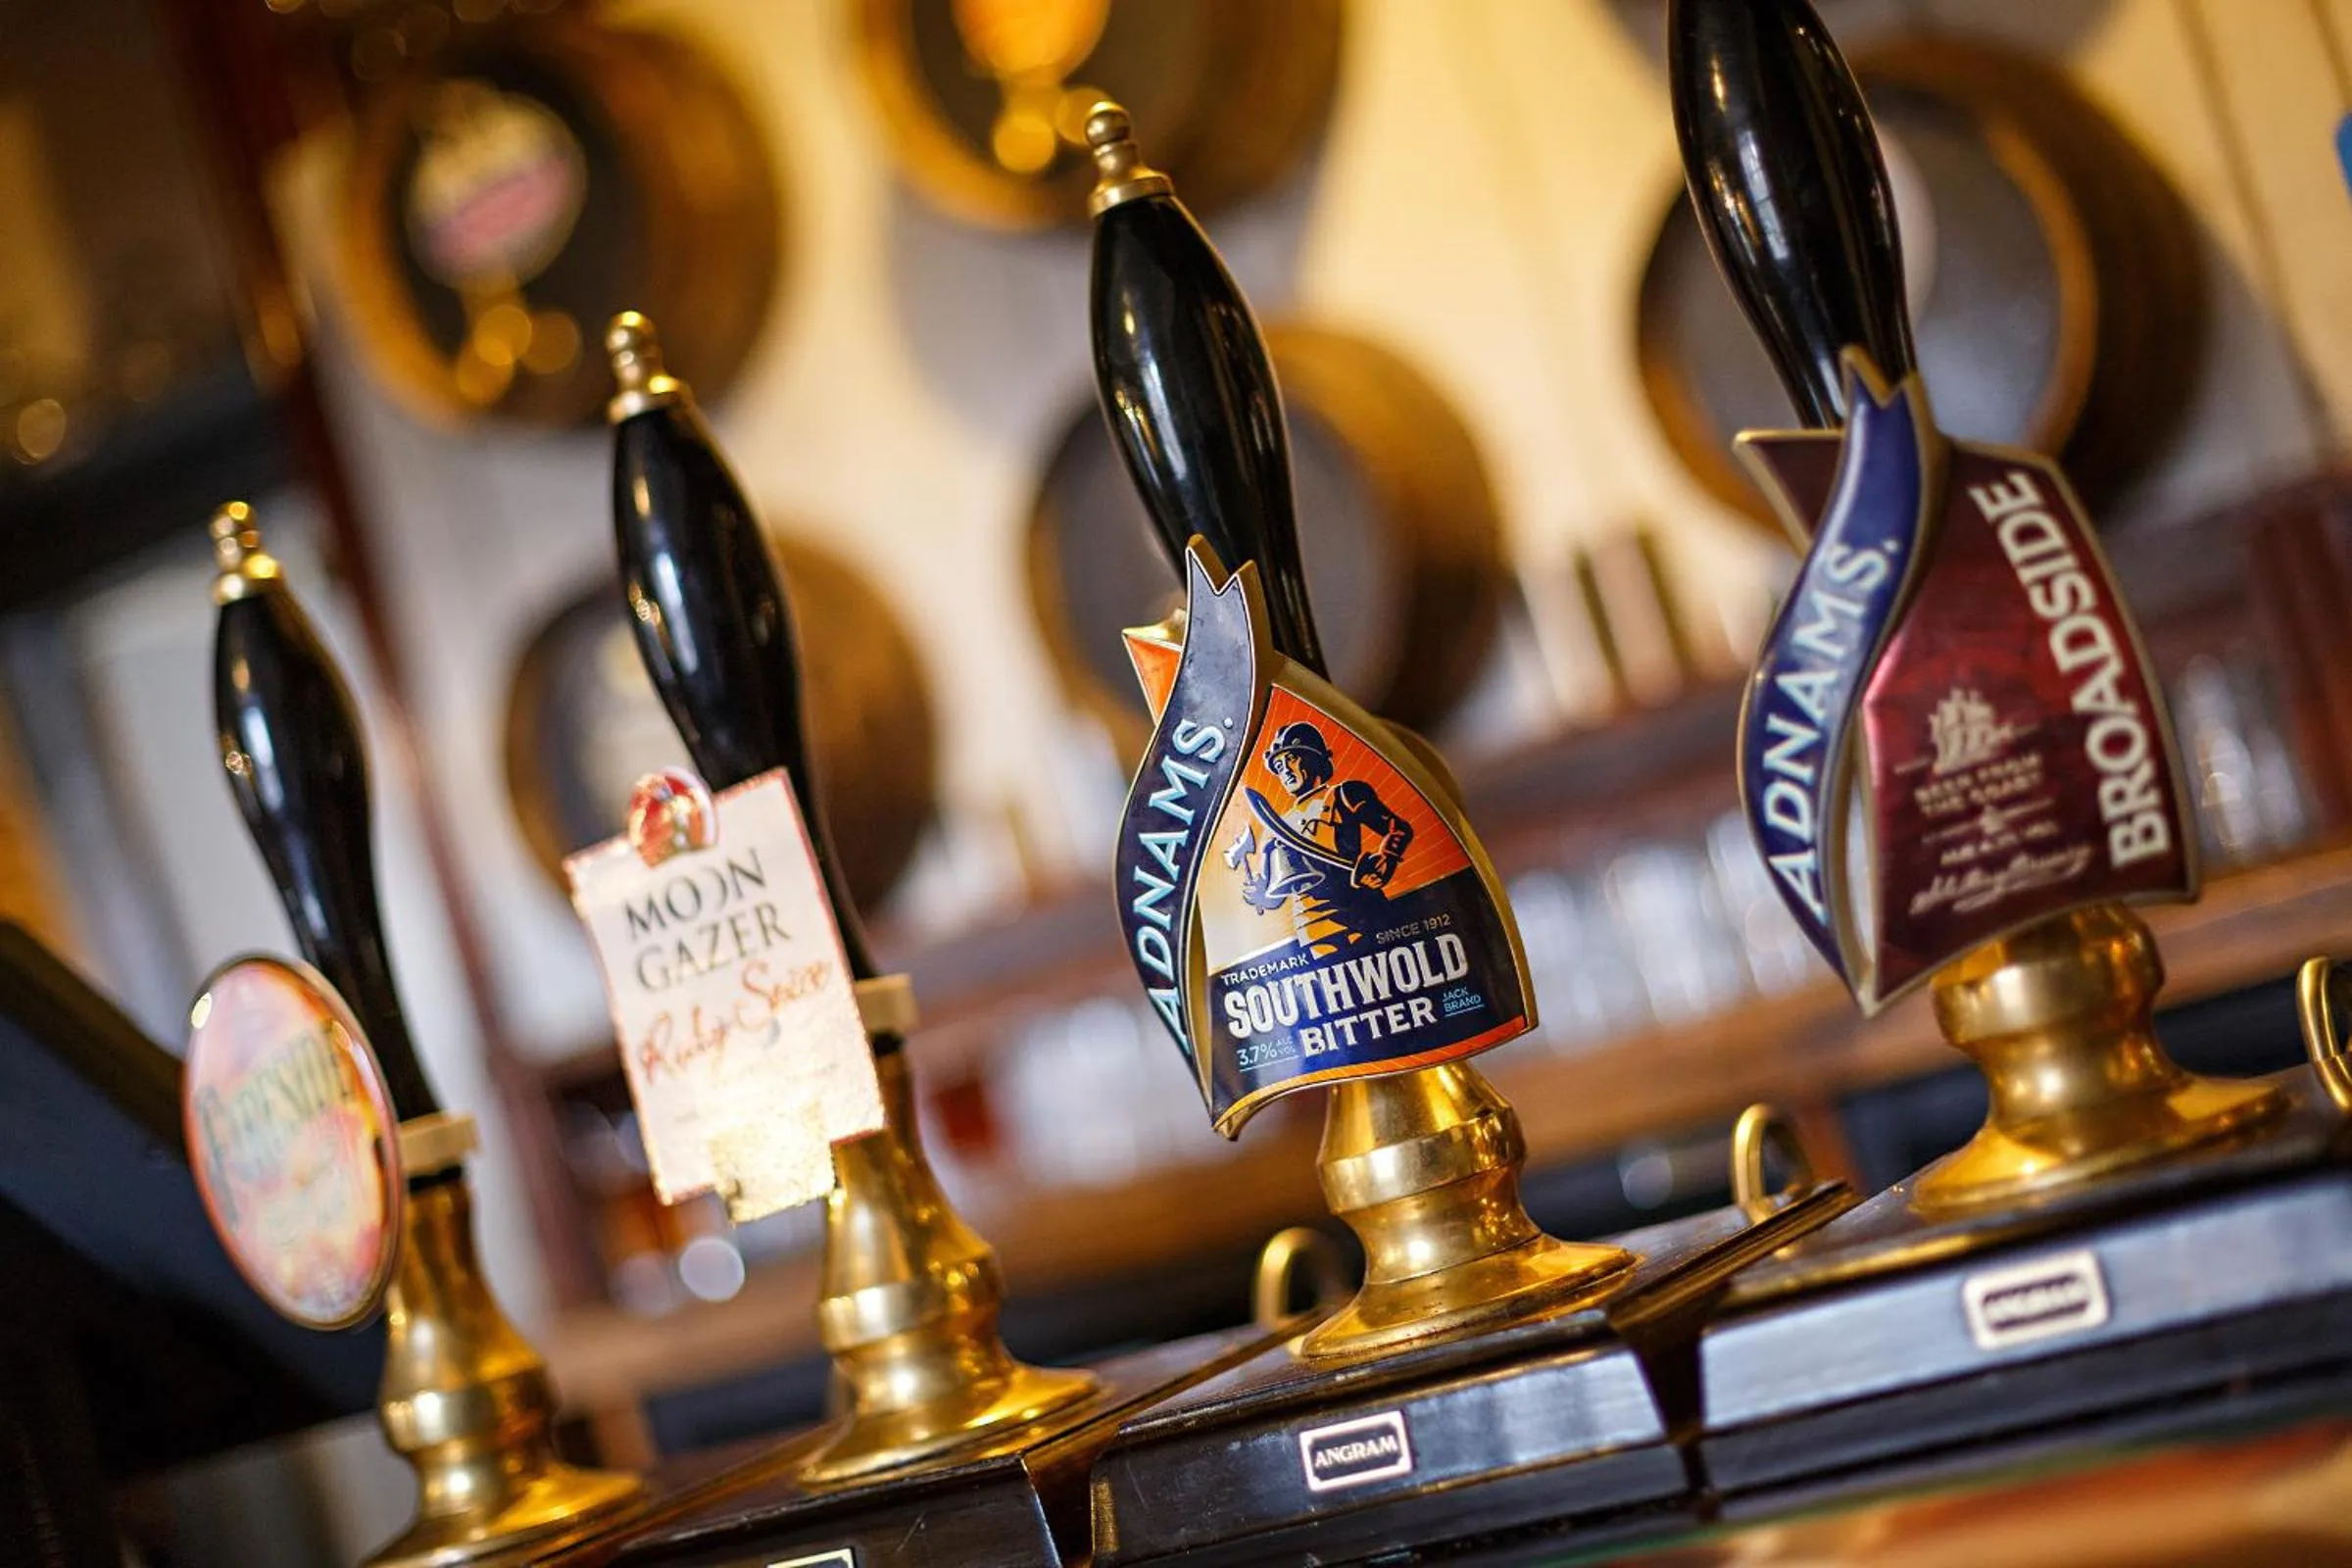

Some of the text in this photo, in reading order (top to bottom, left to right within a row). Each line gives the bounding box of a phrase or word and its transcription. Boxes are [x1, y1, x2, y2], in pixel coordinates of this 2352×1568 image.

[1967, 471, 2172, 869] BROADSIDE
[1376, 913, 1451, 944] SINCE 1912
[635, 901, 793, 995] GAZER
[1221, 953, 1310, 986] TRADEMARK
[1224, 933, 1468, 1039] SOUTHWOLD
[1443, 987, 1469, 1002] JACK
[1444, 994, 1482, 1012] BRAND
[1299, 997, 1439, 1057] BITTER
[1237, 1041, 1278, 1066] 3.7%
[1314, 1434, 1399, 1469] ANGRAM
